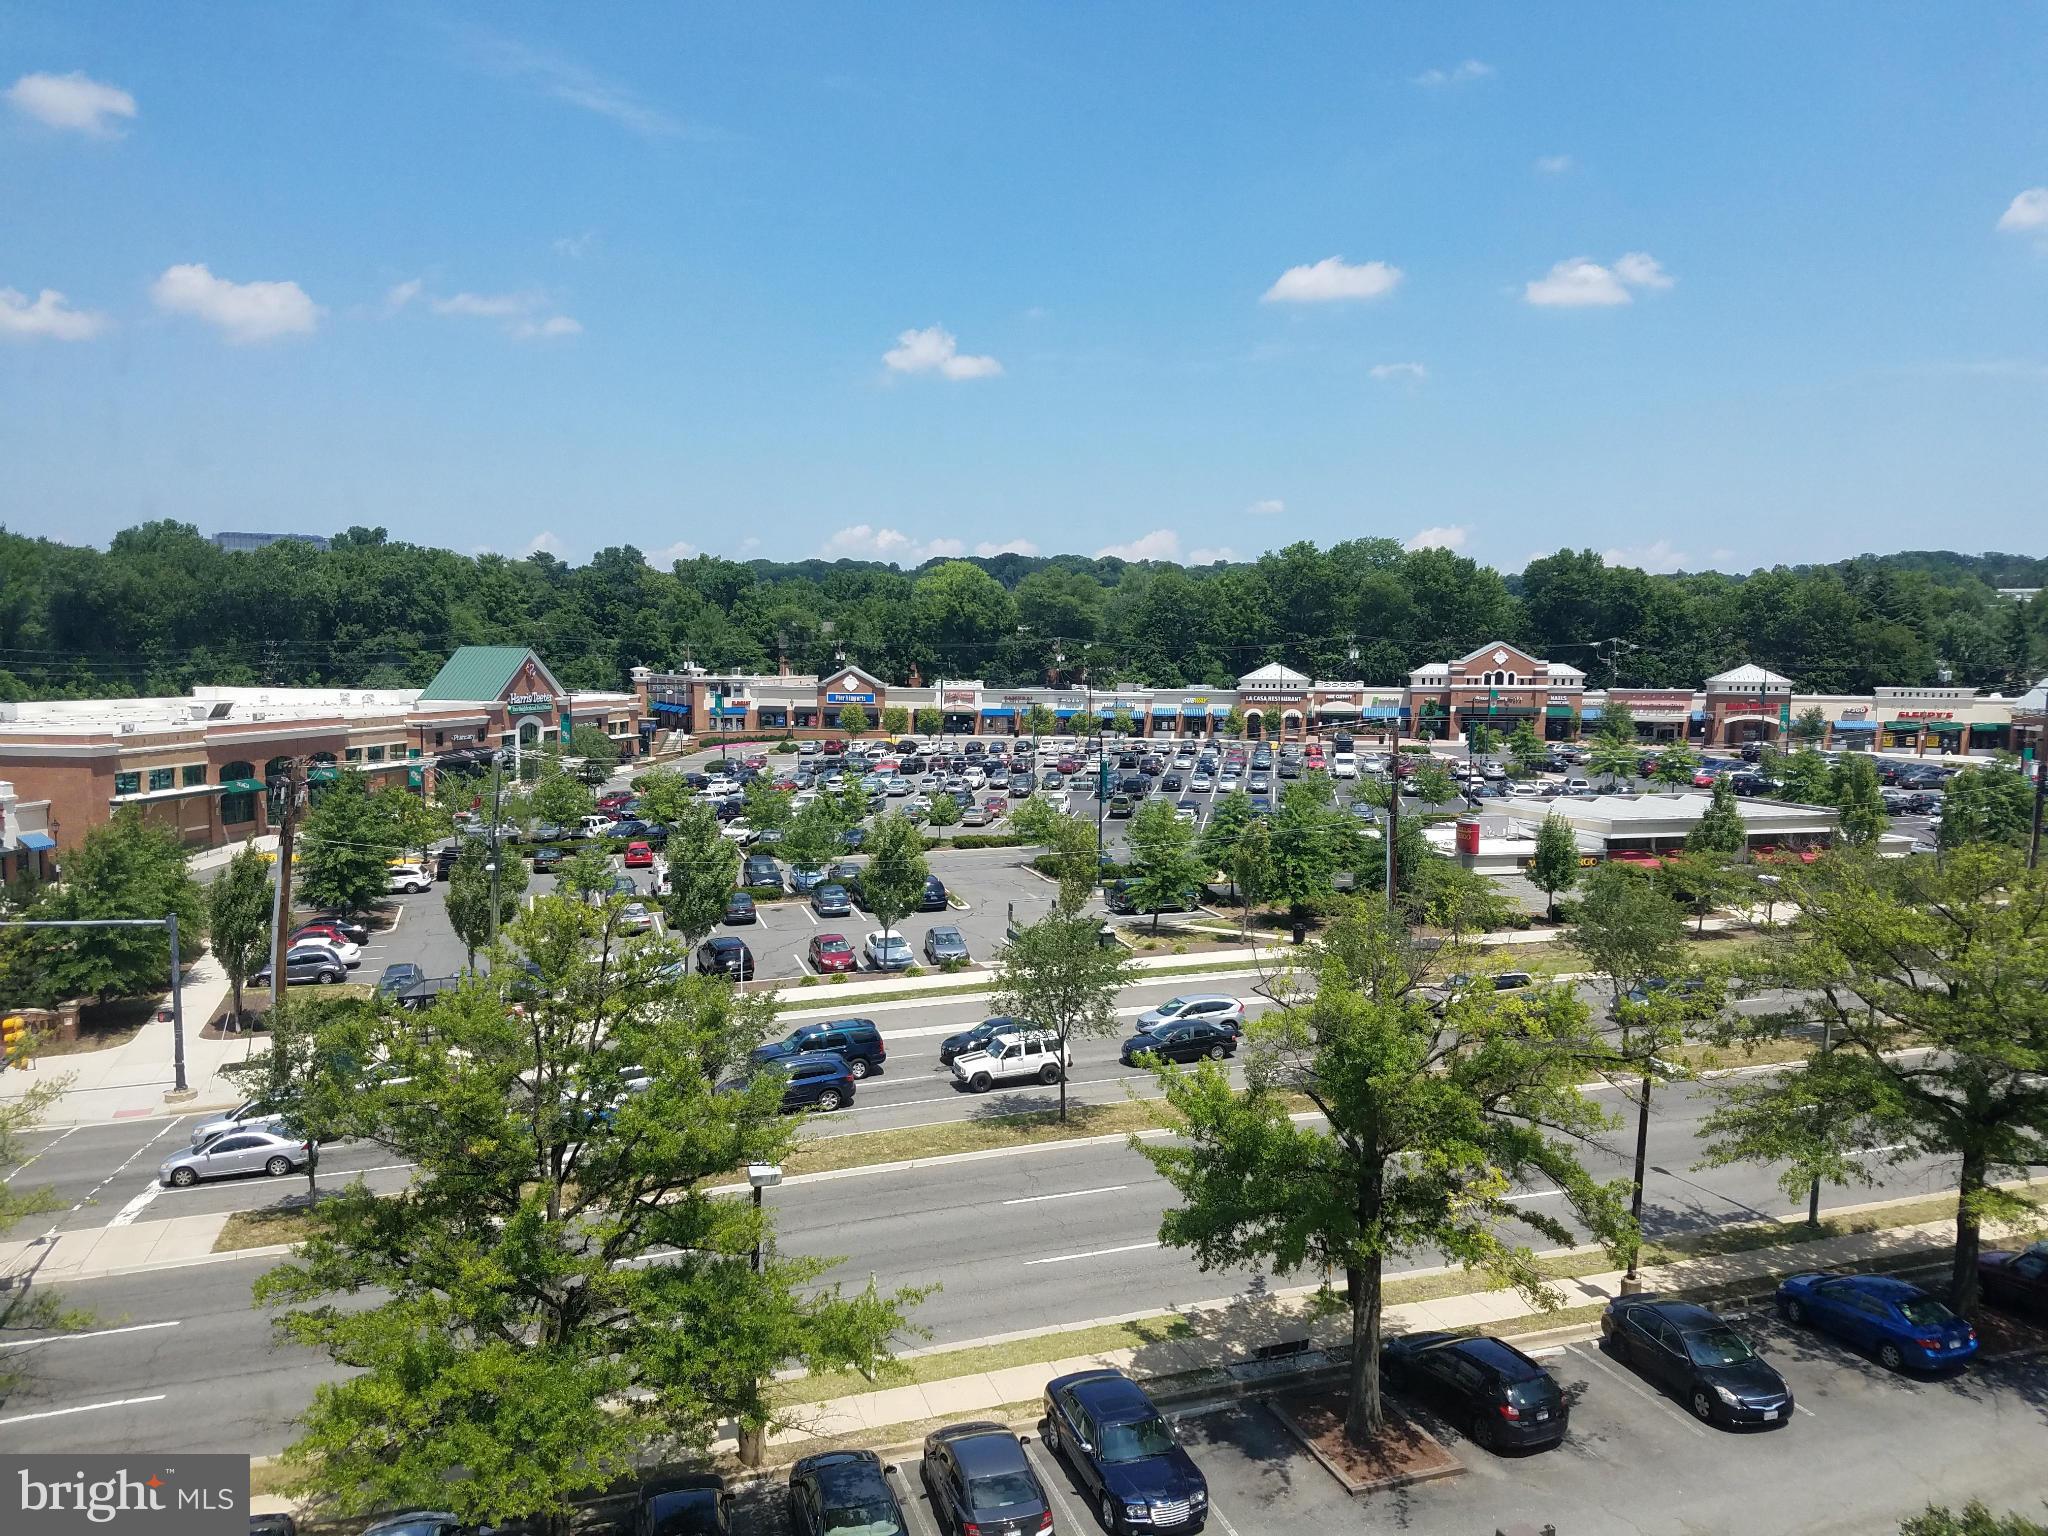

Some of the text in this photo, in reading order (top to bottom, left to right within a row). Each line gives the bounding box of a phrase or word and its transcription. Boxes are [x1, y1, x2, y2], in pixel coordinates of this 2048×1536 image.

[510, 691, 553, 704] Harris Teeter
[1898, 711, 1953, 719] SLEEPY'S
[452, 734, 475, 744] Pharmacy
